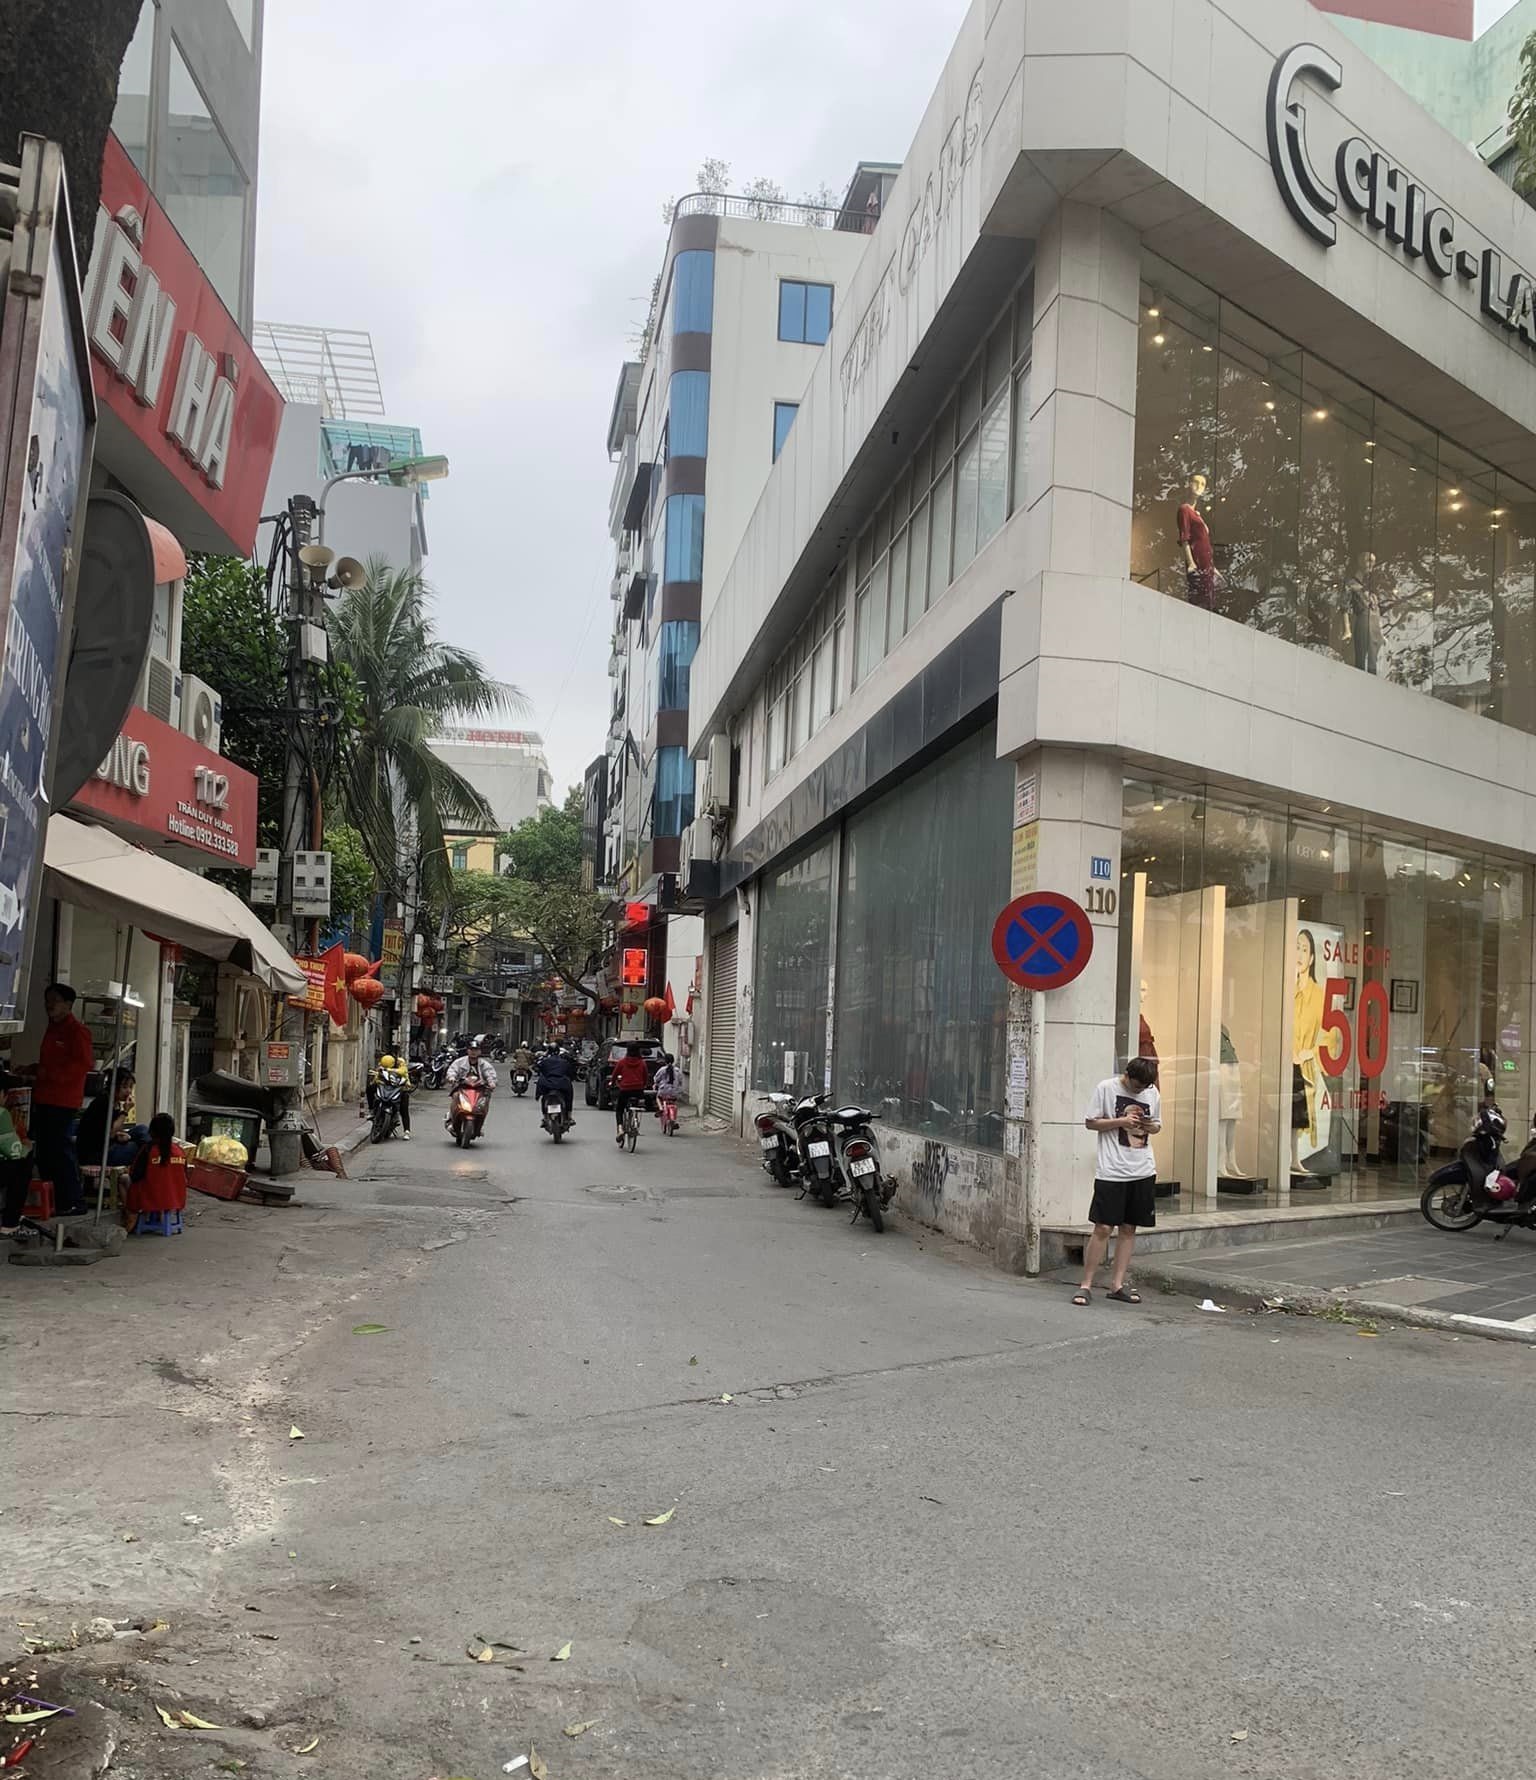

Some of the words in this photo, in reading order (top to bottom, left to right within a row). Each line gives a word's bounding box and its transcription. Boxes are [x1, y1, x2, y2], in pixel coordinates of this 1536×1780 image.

[166, 330, 240, 491] HÀ
[194, 765, 229, 810] 112
[198, 810, 214, 825] DUY
[1092, 857, 1111, 877] 110
[1084, 886, 1118, 915] 110
[1323, 939, 1359, 965] SALE
[1363, 945, 1391, 969] OFF
[1320, 1089, 1344, 1110] ALL
[1349, 1089, 1386, 1110] ITEMS
